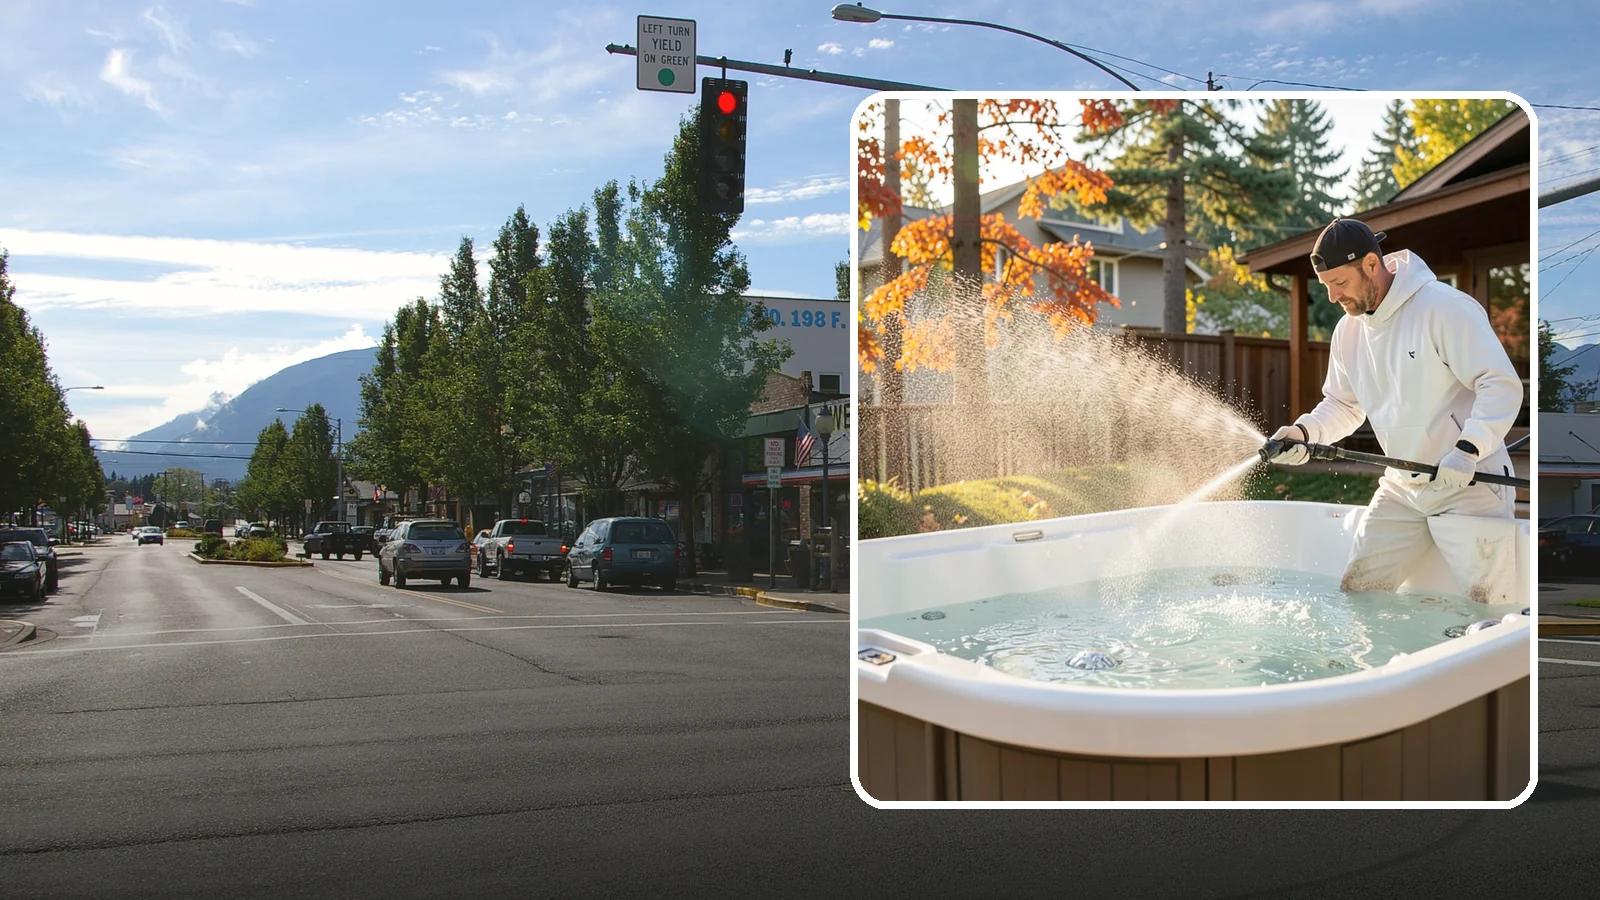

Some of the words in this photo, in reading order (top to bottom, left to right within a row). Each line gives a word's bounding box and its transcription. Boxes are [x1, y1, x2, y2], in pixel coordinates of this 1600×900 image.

[643, 24, 663, 34] LEFT
[668, 26, 690, 36] TURN
[652, 38, 682, 51] YIELD
[644, 54, 656, 63] ON
[661, 55, 688, 65] GREEN
[791, 309, 826, 328] 198
[831, 311, 846, 328] F.
